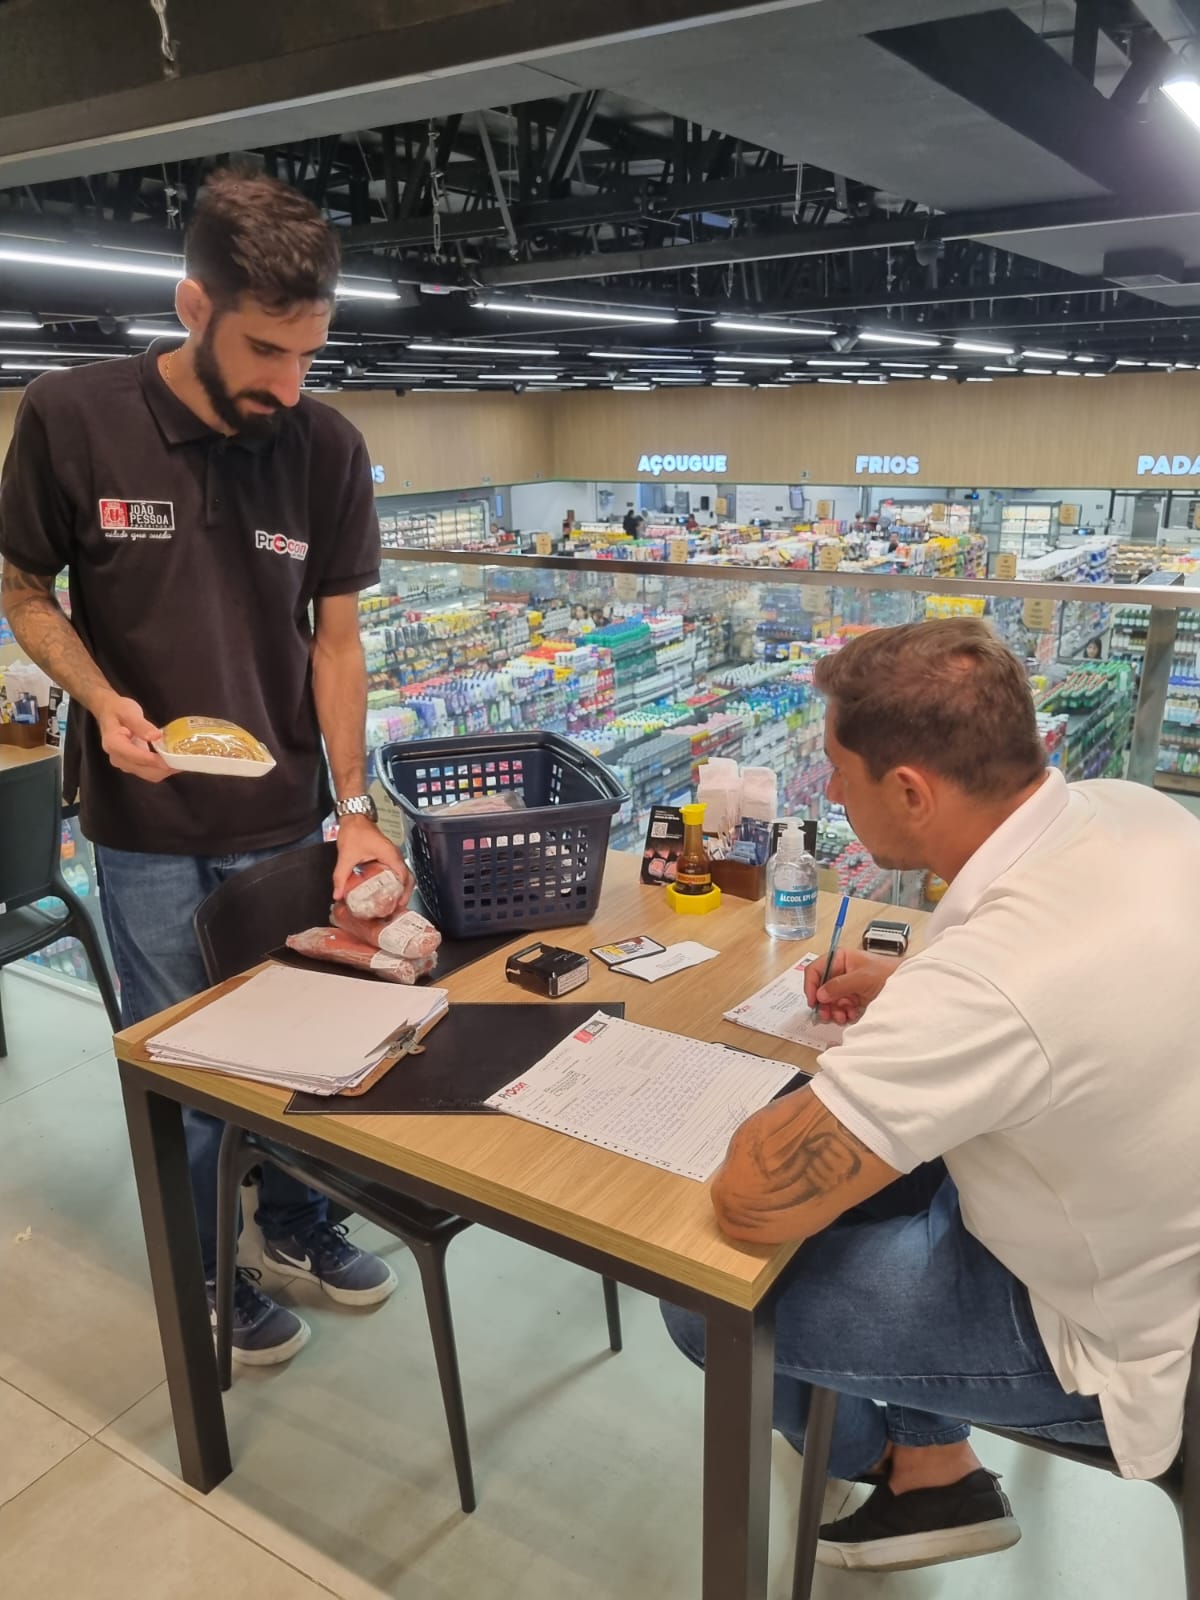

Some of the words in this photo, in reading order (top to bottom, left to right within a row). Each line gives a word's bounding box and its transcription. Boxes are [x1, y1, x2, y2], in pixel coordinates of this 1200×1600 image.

[637, 454, 728, 476] AÇOUGUE
[855, 455, 920, 475] FRIOS
[1137, 455, 1200, 475] PADA
[130, 502, 153, 514] JOÃO
[130, 514, 169, 525] PESSOA
